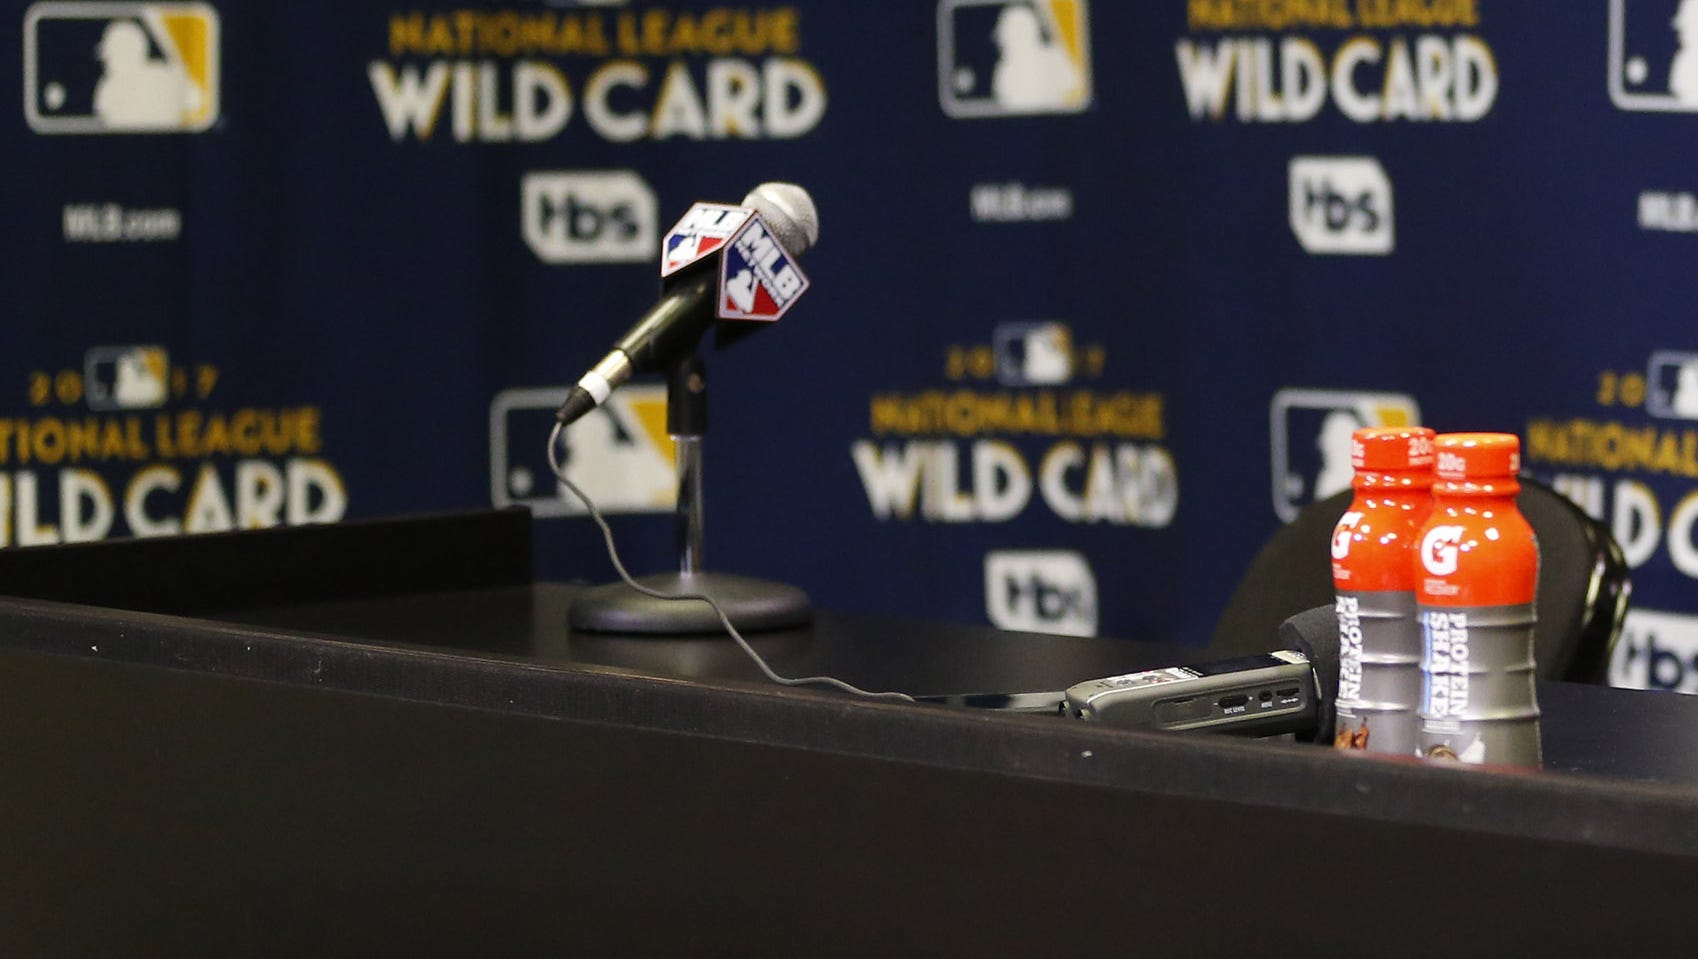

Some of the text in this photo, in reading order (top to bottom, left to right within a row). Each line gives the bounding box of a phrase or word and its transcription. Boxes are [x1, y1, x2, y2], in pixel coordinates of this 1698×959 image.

[389, 7, 798, 58] NATIONAL LEAGUE
[367, 59, 829, 144] WILD CARD
[1176, 36, 1499, 123] WILD CARD
[740, 220, 801, 301] MLB
[0, 406, 322, 465] TIONAL LEAGUE
[0, 460, 348, 549] ILD CARD
[851, 440, 1033, 523] WILD
[1421, 525, 1467, 576] G
[1429, 611, 1451, 719] SHAKE
[1450, 612, 1470, 715] PROTEIN
